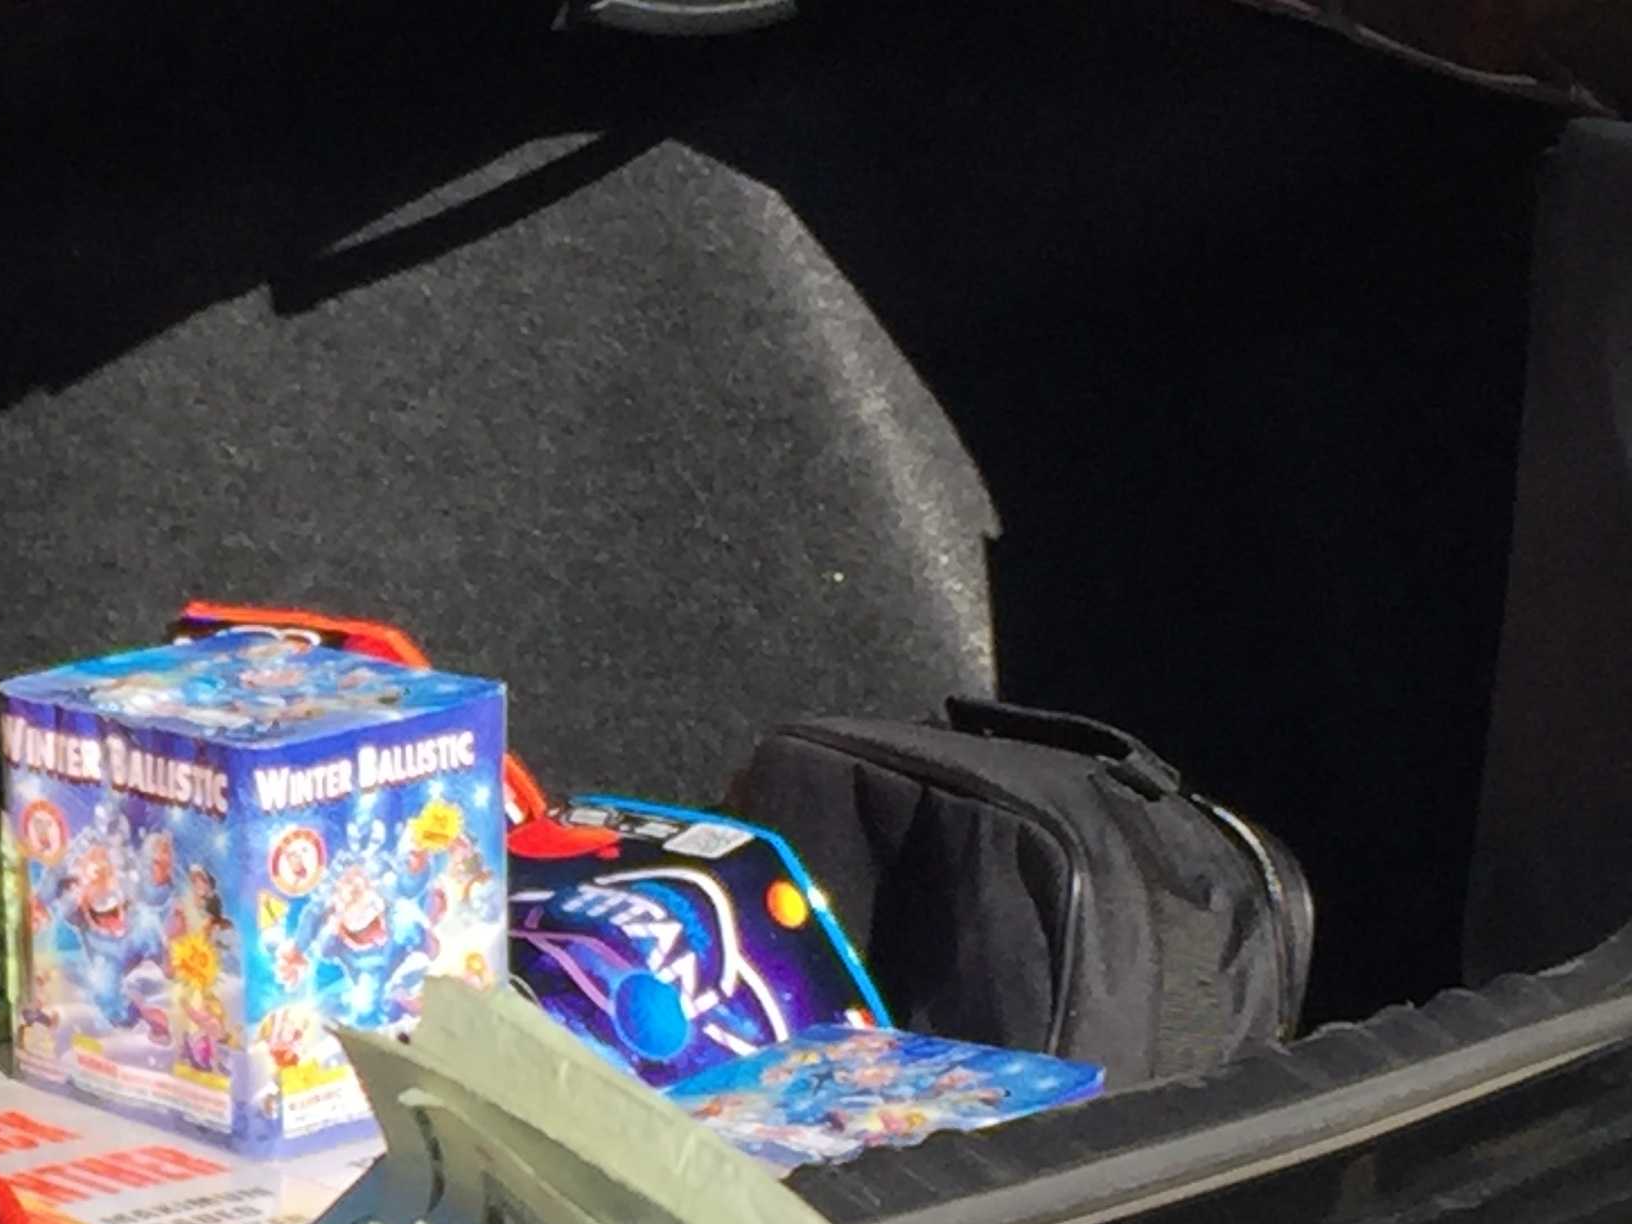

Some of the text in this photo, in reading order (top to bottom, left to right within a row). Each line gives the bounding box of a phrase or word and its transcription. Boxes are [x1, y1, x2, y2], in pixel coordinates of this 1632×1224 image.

[0, 714, 229, 813] WINTER BALLISTIC
[254, 730, 475, 811] WINTER BALLISTIC
